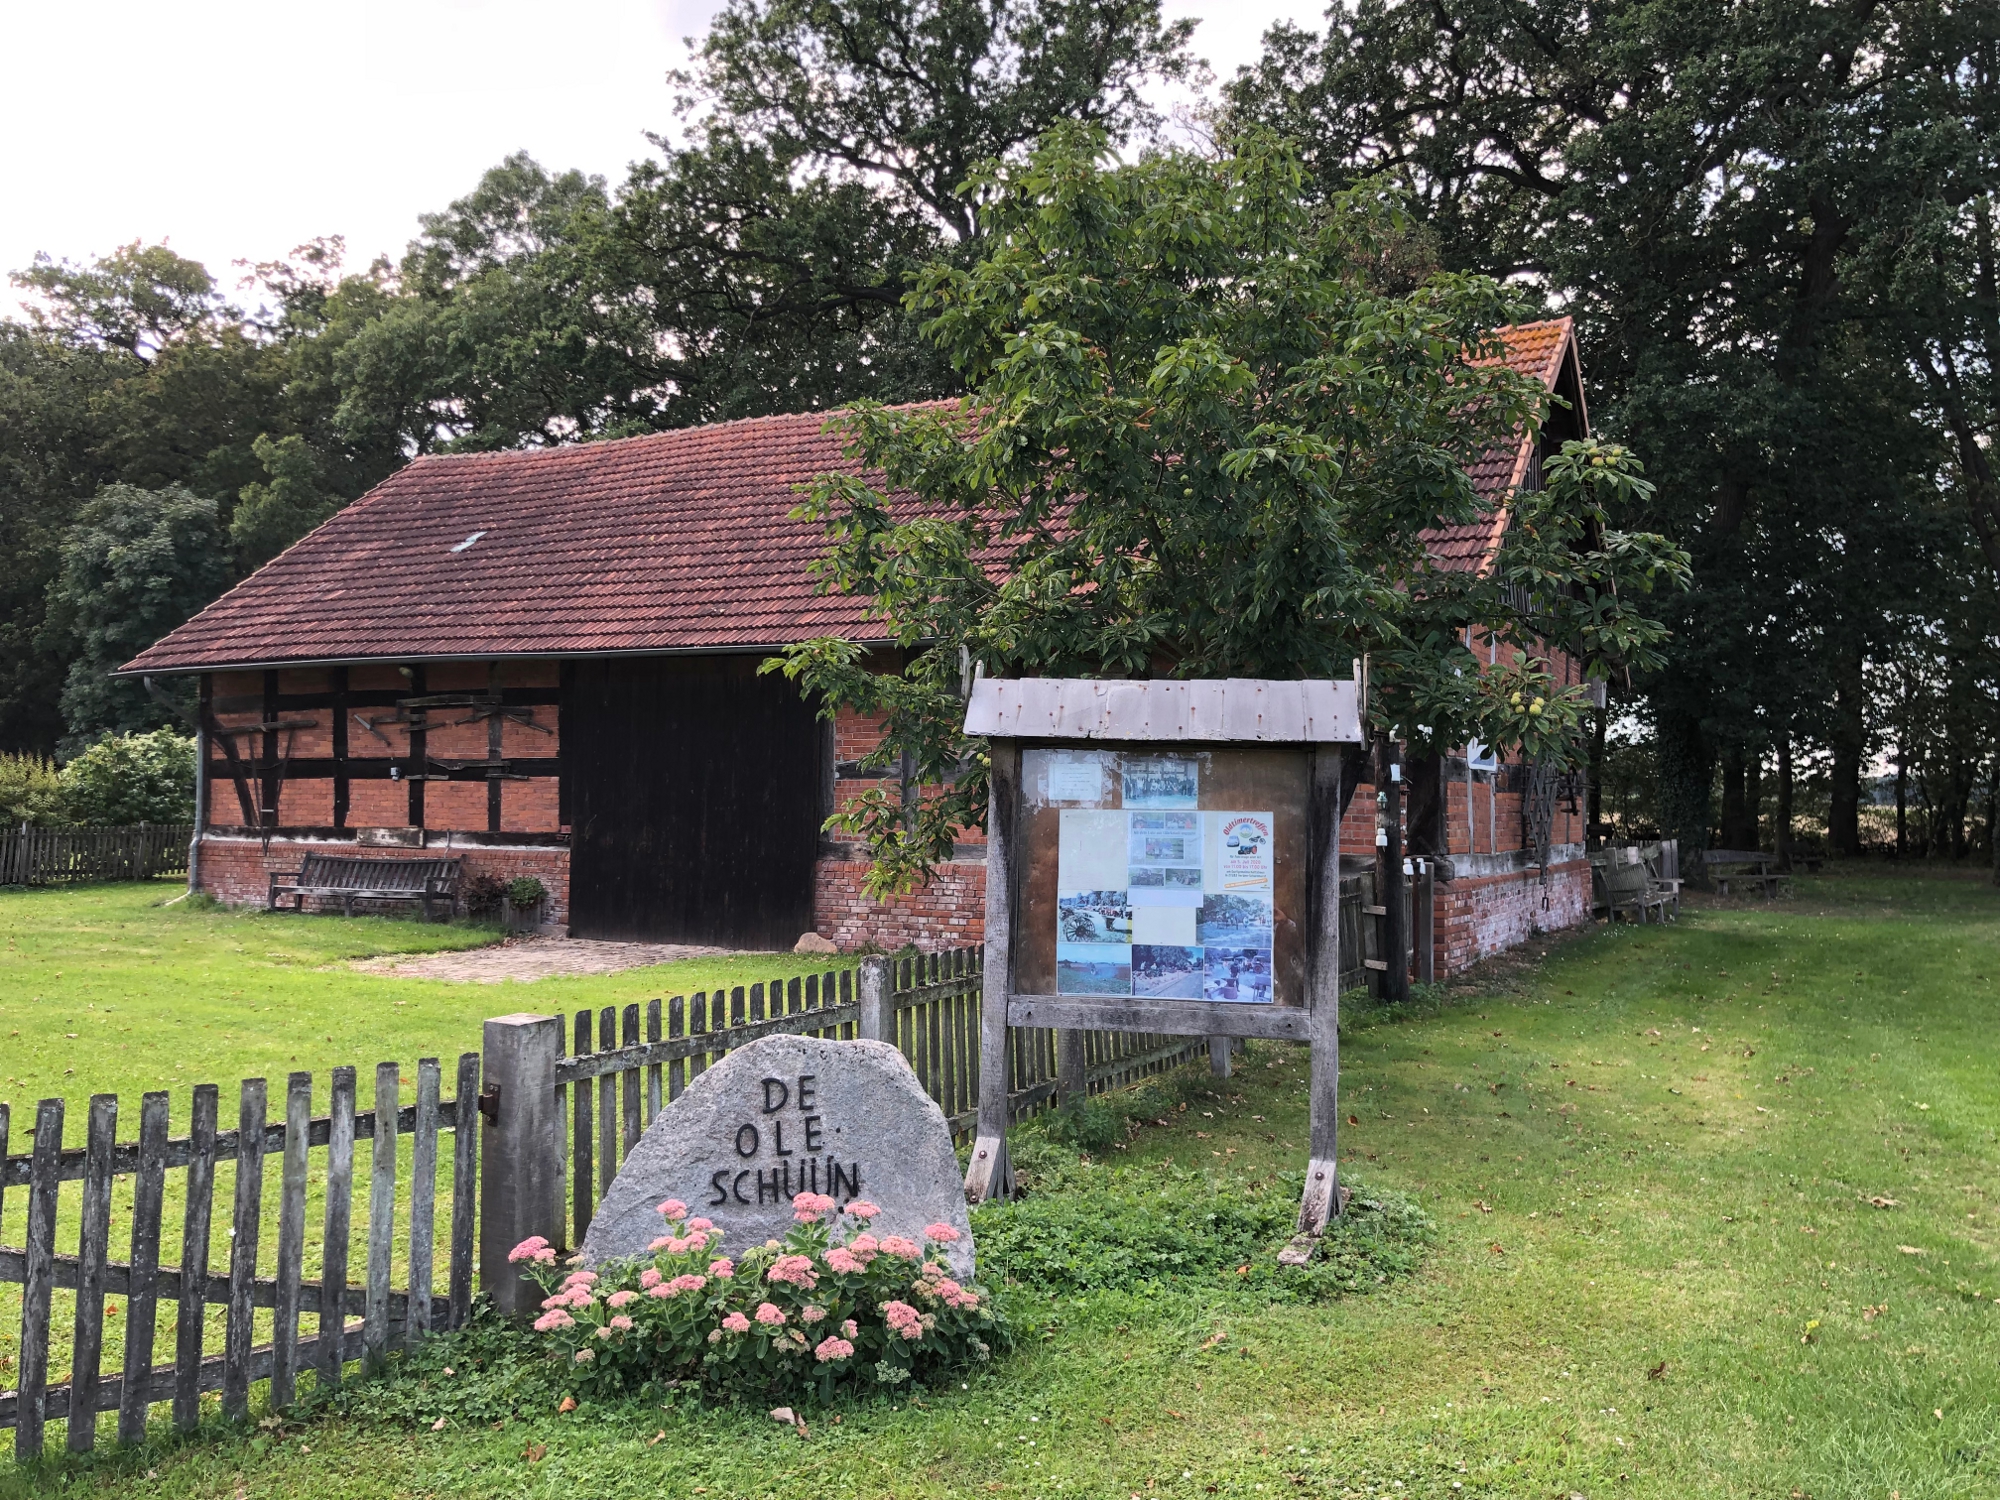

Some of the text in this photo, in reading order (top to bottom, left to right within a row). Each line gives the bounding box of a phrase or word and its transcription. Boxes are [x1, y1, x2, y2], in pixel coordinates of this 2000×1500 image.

[1223, 817, 1268, 836] Oldtimertreffen
[761, 1075, 815, 1114] DE
[735, 1115, 822, 1159] OLE
